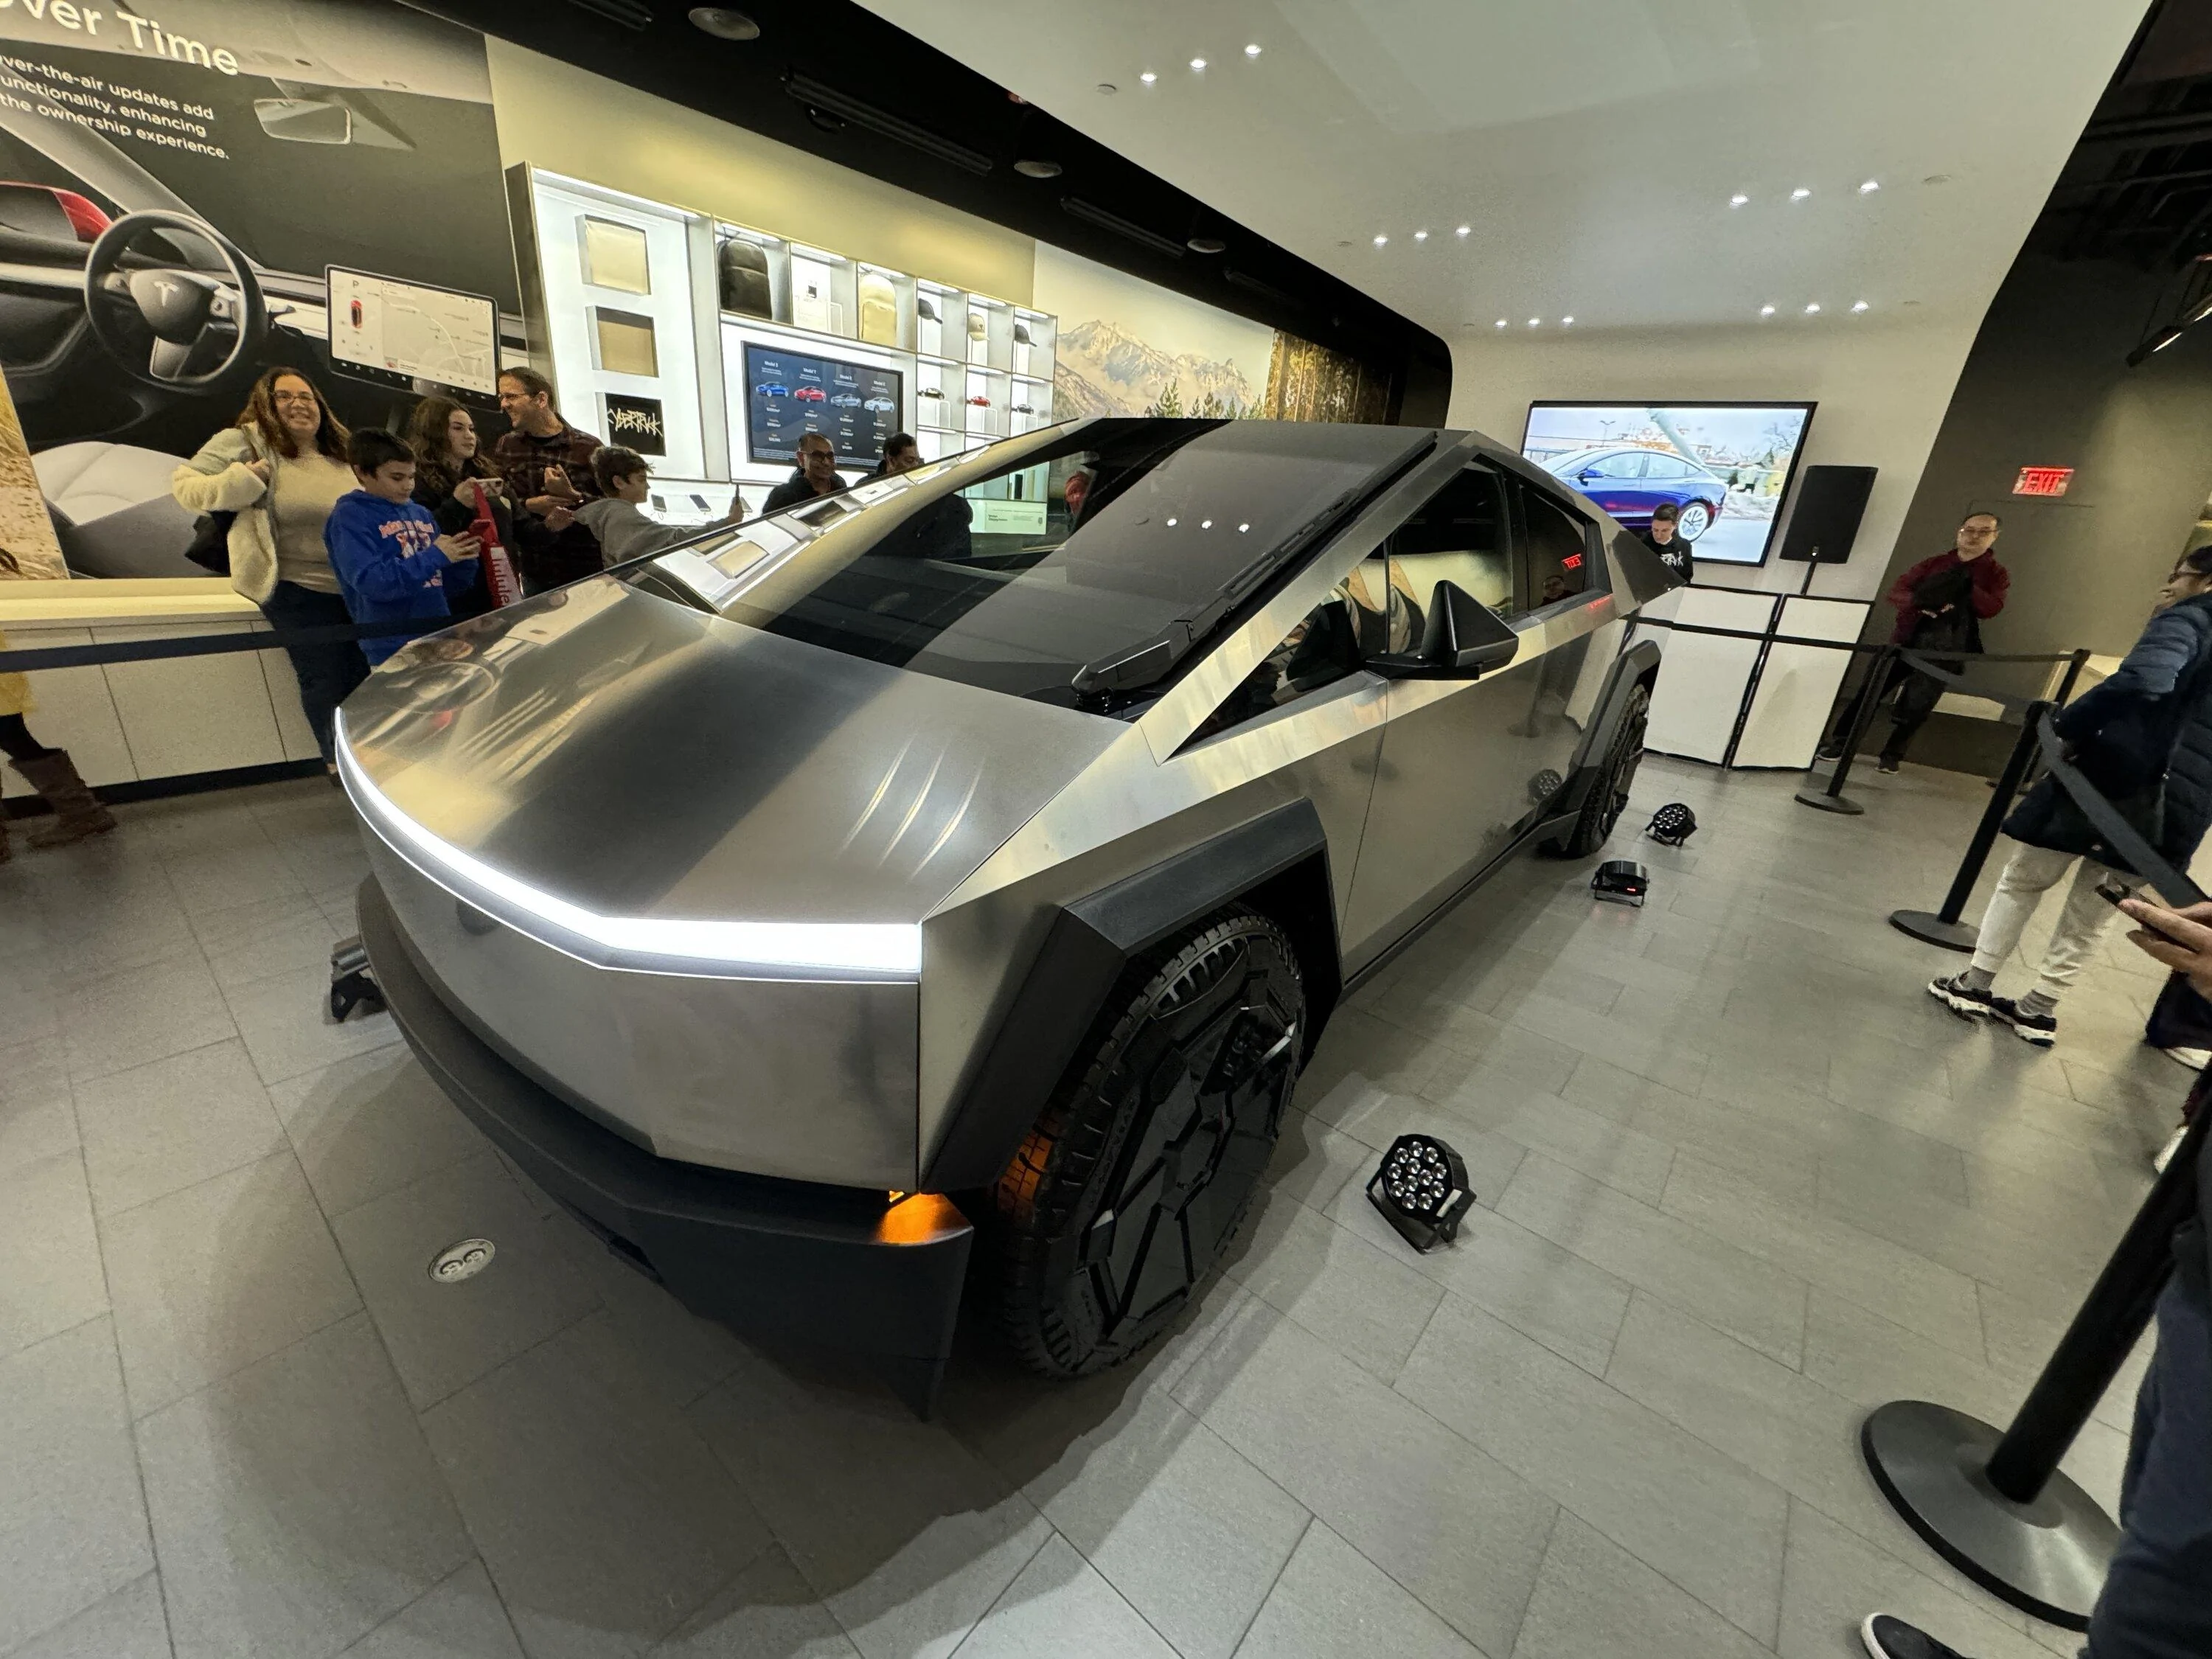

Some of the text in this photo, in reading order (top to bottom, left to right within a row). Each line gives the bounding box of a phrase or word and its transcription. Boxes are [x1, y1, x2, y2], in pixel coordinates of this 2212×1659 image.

[0, 0, 238, 75] ver Time
[0, 55, 215, 121] ver-the-air updates add
[0, 93, 230, 160] the ownership experience.
[119, 105, 207, 139] enhancing
[2023, 472, 2065, 494] EXIT
